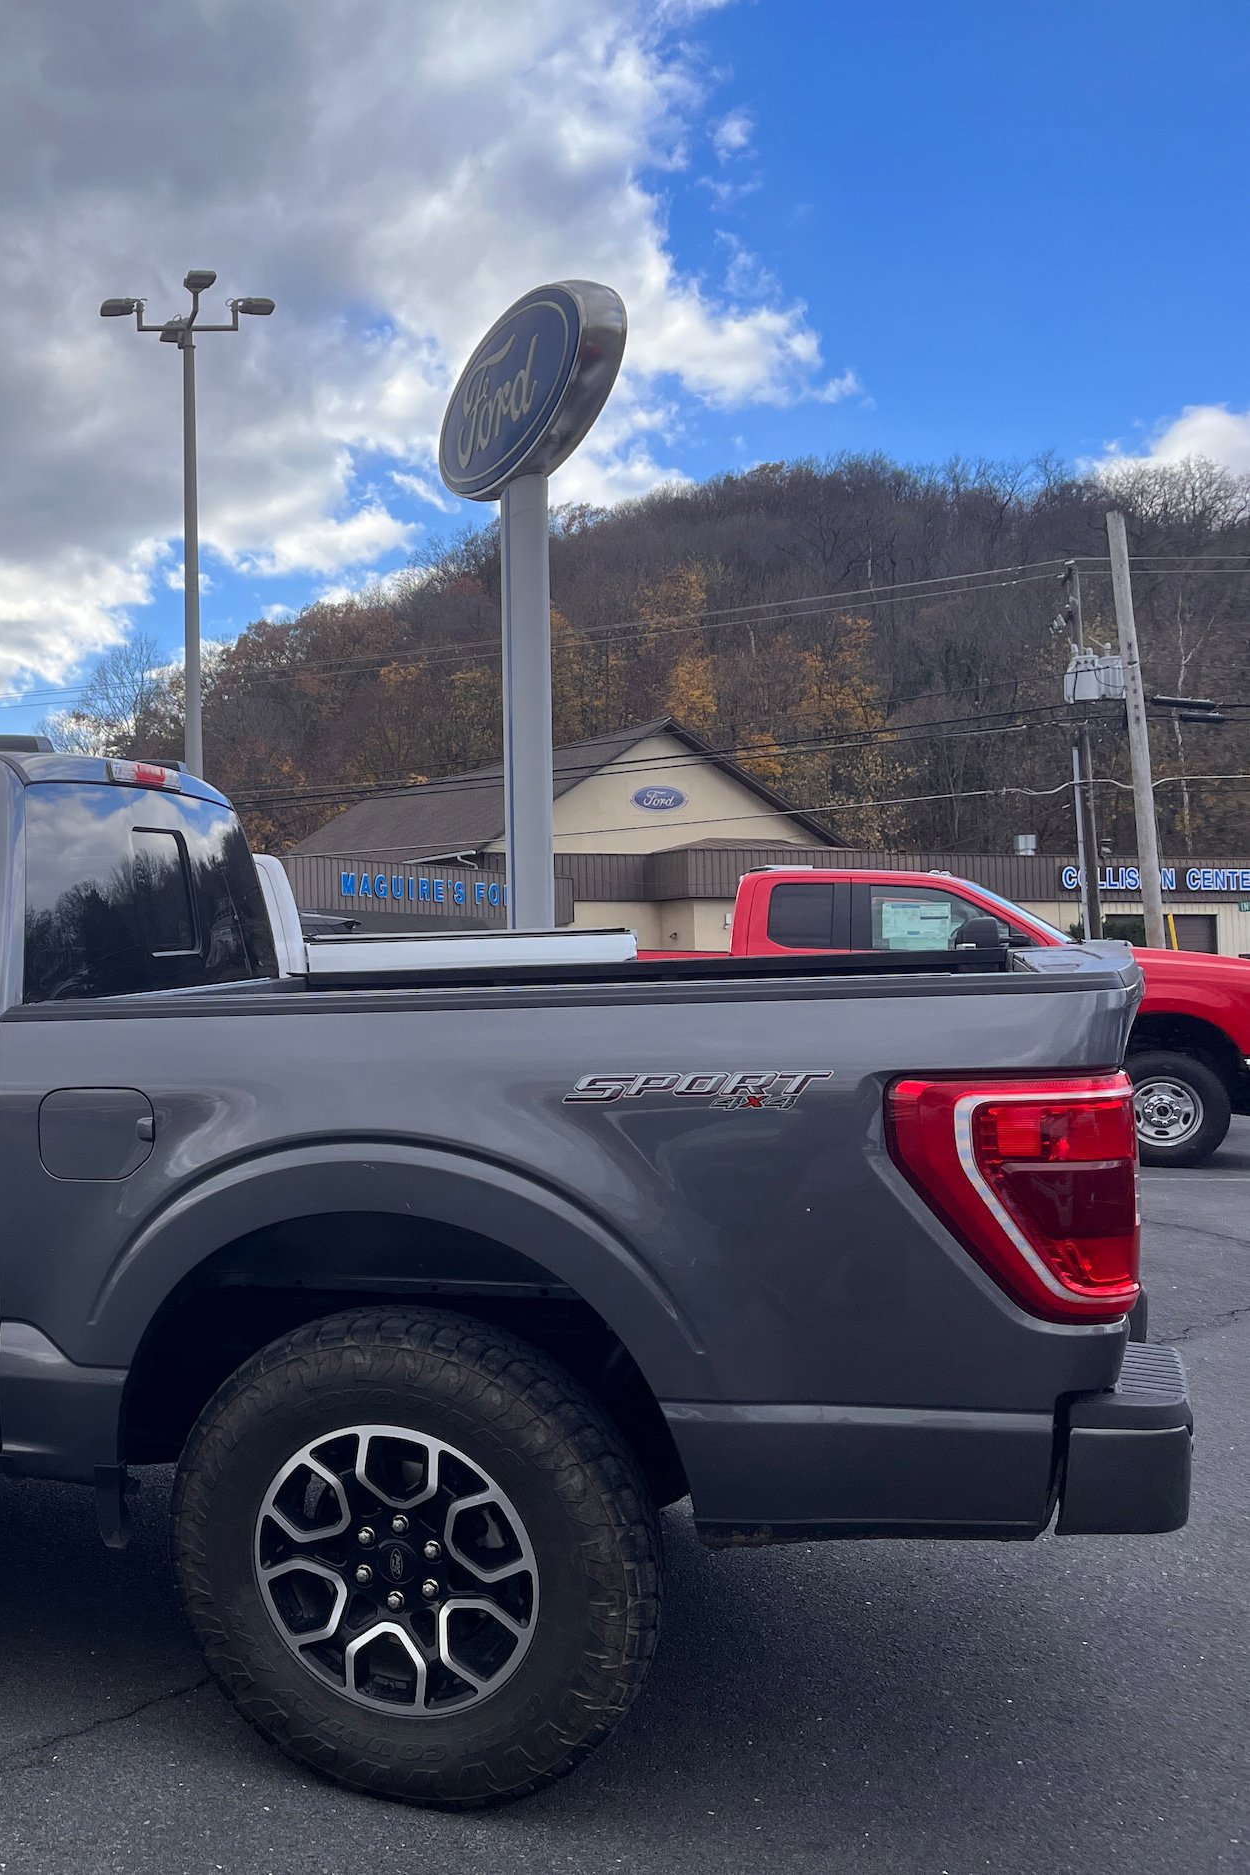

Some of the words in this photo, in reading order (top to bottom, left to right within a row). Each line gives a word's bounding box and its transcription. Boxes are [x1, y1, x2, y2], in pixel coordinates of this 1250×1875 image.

[458, 333, 538, 469] Ford
[643, 789, 675, 807] Ford
[341, 871, 465, 905] MAGUIRE'S
[1062, 866, 1176, 890] CLLISN
[561, 1069, 835, 1104] SPORT
